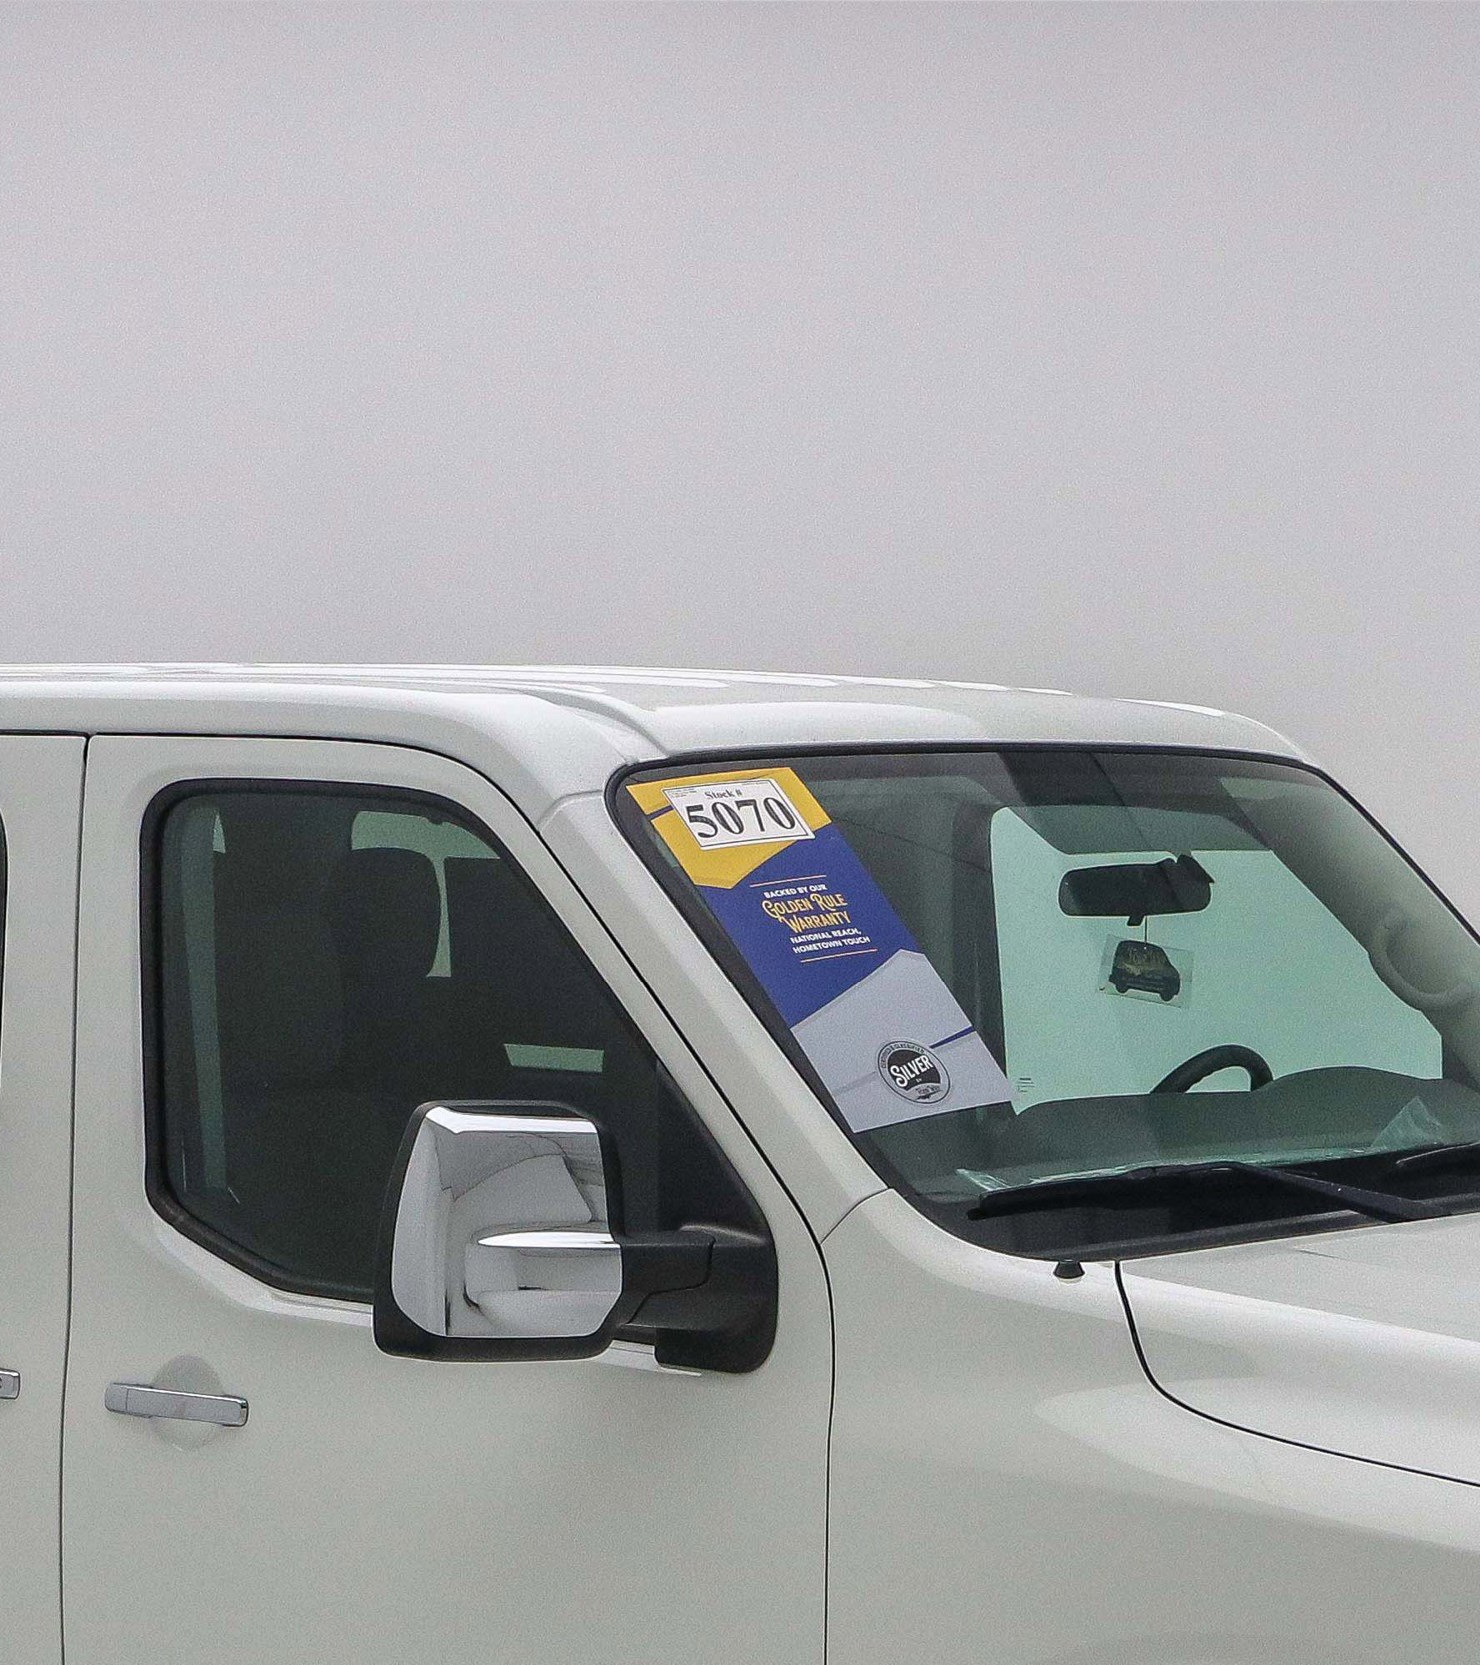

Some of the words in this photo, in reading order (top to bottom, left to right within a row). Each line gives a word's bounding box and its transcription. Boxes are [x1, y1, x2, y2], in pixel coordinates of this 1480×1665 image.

[704, 789, 733, 800] Stock
[735, 788, 743, 797] #
[686, 797, 796, 839] 5070
[763, 887, 797, 899] BACKED
[797, 885, 808, 894] BY
[808, 884, 828, 892] OUR
[778, 911, 851, 934] WARRANTY
[790, 932, 832, 944] NATIONAL
[832, 928, 862, 938] REACH,
[792, 942, 844, 954] HOMETOWN
[843, 936, 871, 946] TOUCH
[890, 1054, 934, 1088] SILVER
